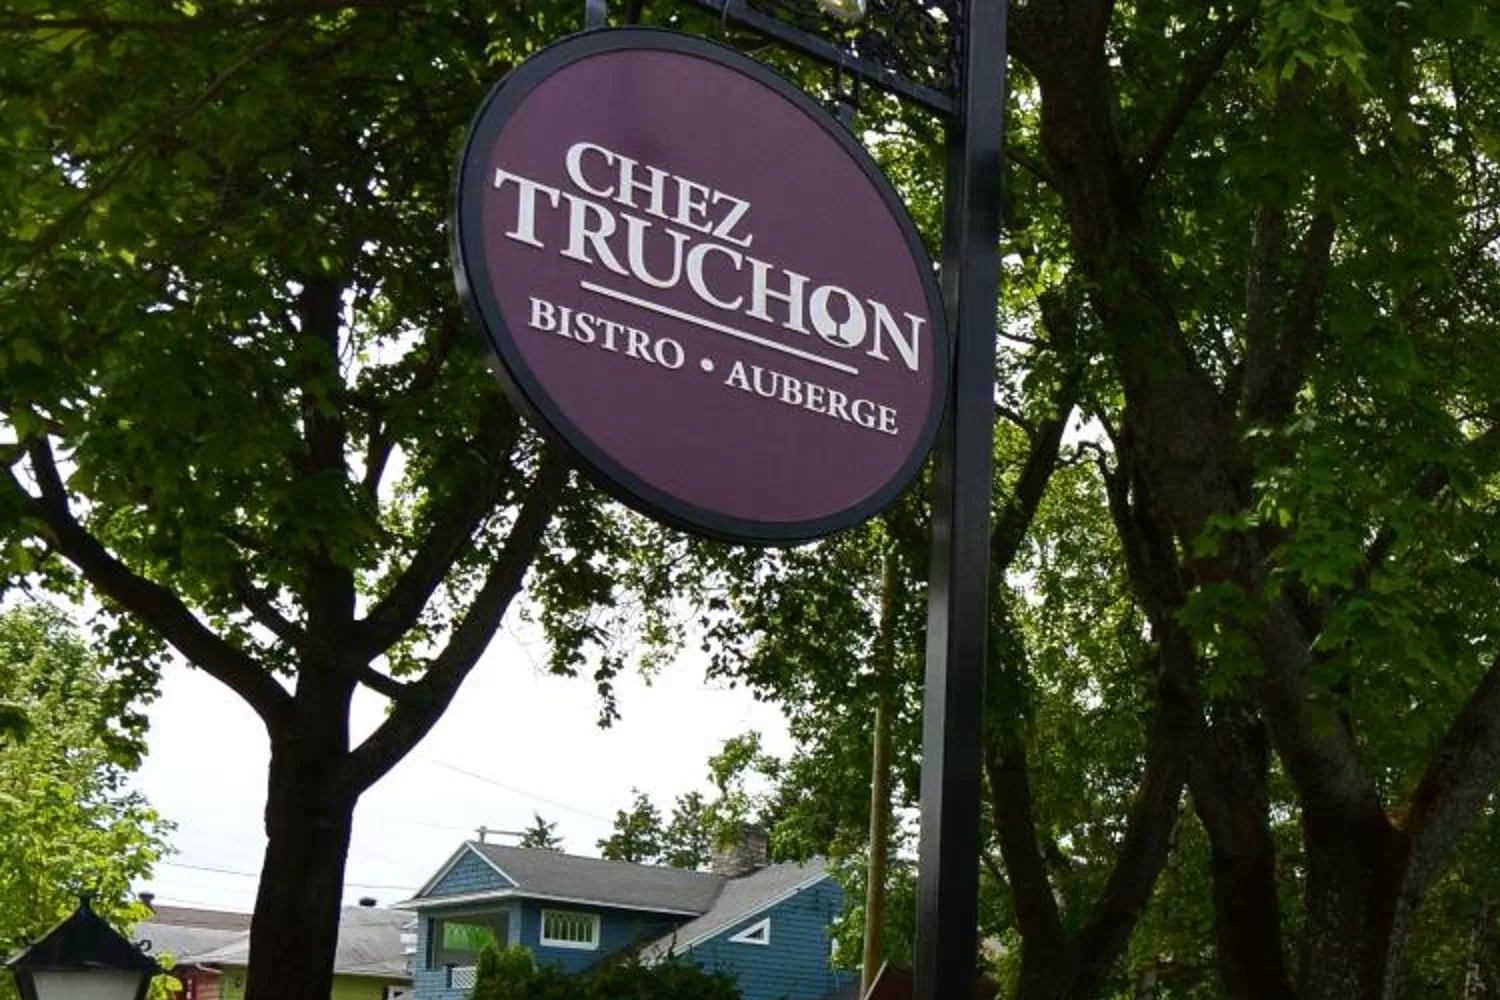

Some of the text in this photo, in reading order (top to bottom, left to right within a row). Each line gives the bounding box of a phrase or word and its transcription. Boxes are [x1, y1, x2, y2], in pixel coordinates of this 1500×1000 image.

[565, 141, 754, 247] CHEZ
[494, 168, 927, 372] TRUCHON
[528, 296, 899, 436] BISTRO AUBERGE
